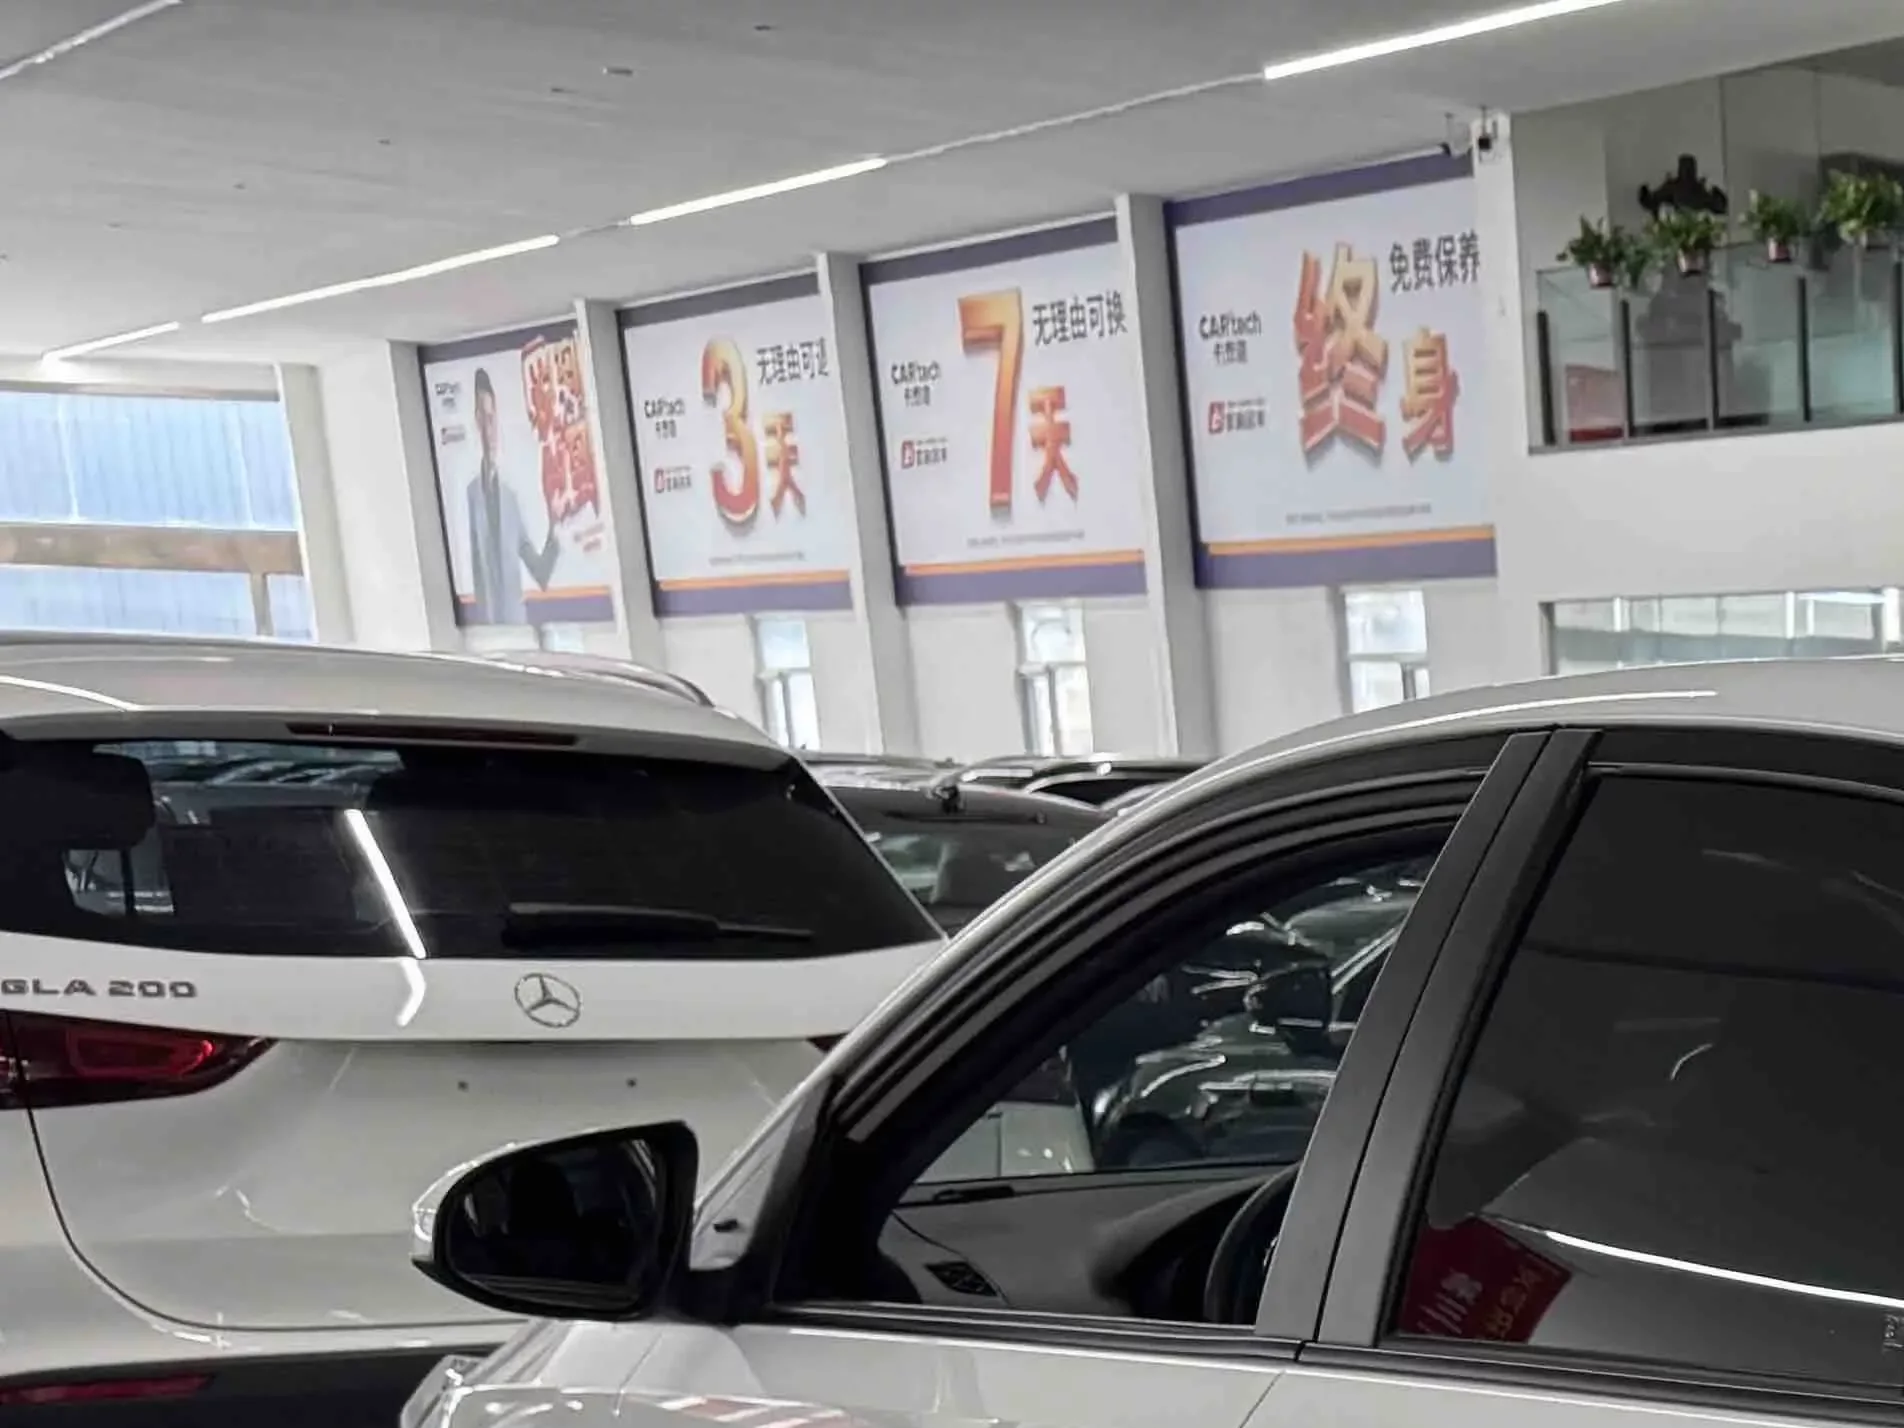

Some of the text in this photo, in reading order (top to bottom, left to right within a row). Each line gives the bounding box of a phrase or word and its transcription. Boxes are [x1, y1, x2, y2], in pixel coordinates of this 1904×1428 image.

[1389, 230, 1480, 293] 免费保养
[1032, 290, 1128, 347] 无理由可换
[1, 978, 198, 998] GLA 200
